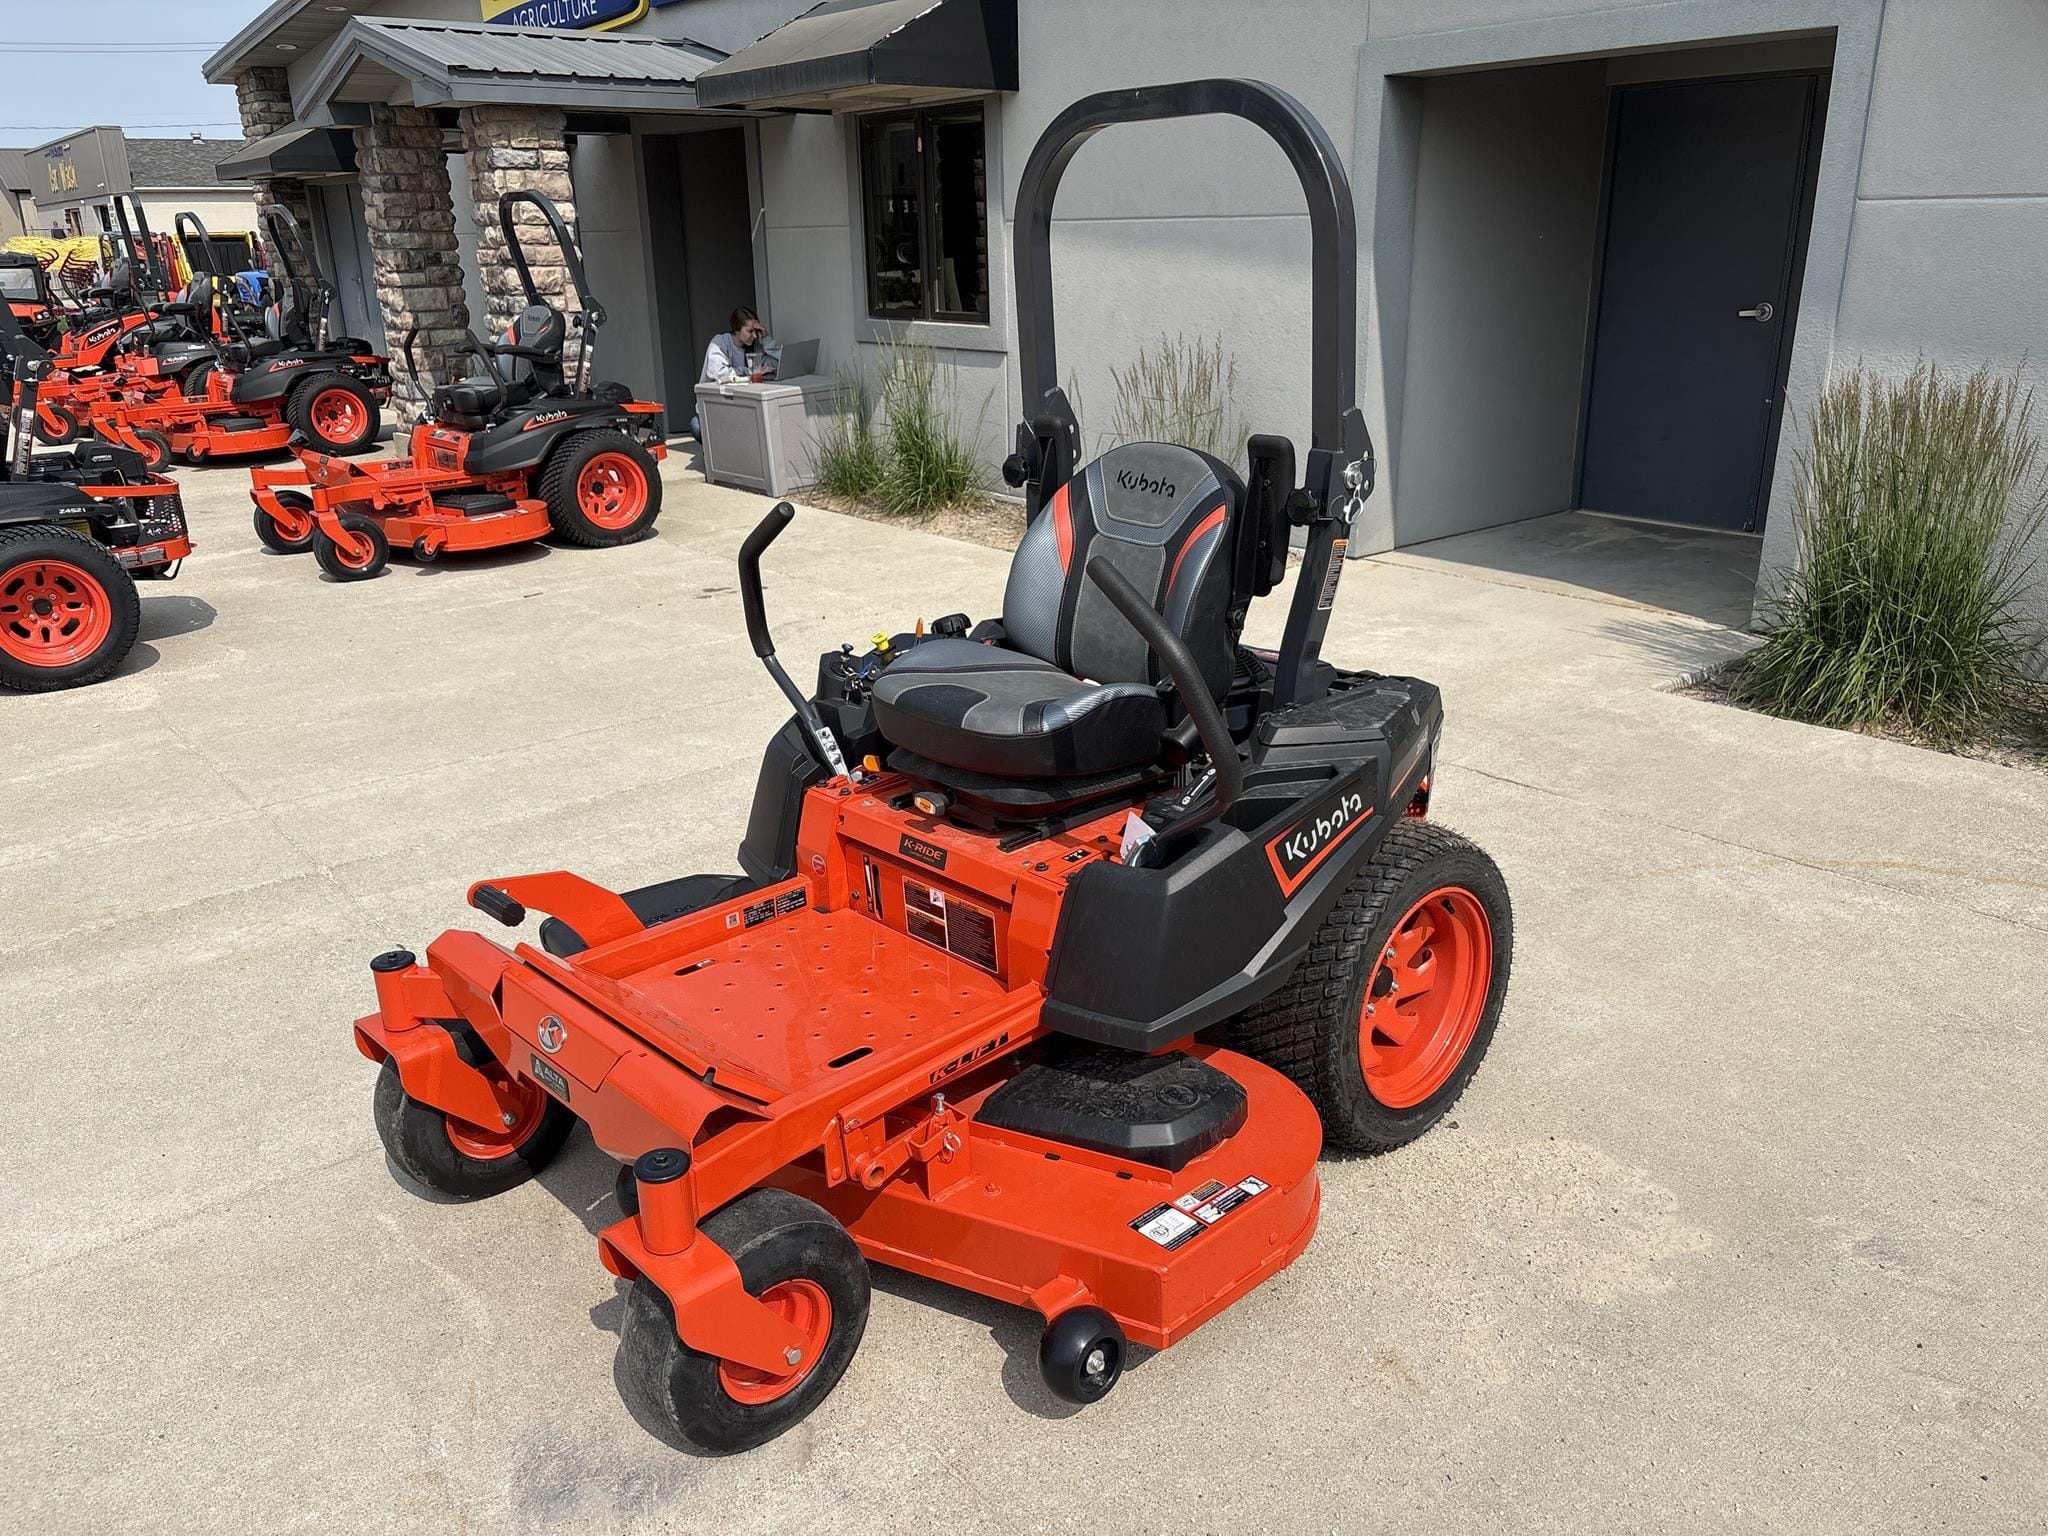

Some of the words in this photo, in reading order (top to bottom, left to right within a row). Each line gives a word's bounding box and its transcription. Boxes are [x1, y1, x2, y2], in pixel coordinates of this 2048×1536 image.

[512, 0, 598, 28] AGRICULTURE
[88, 327, 116, 343] Kubota
[535, 410, 568, 422] Kubota
[1117, 469, 1176, 498] Kubota
[1284, 793, 1362, 862] Kubota
[904, 839, 943, 861] K-RIDE
[931, 1032, 1009, 1084] K-LIFT
[544, 1067, 566, 1089] ALTA
